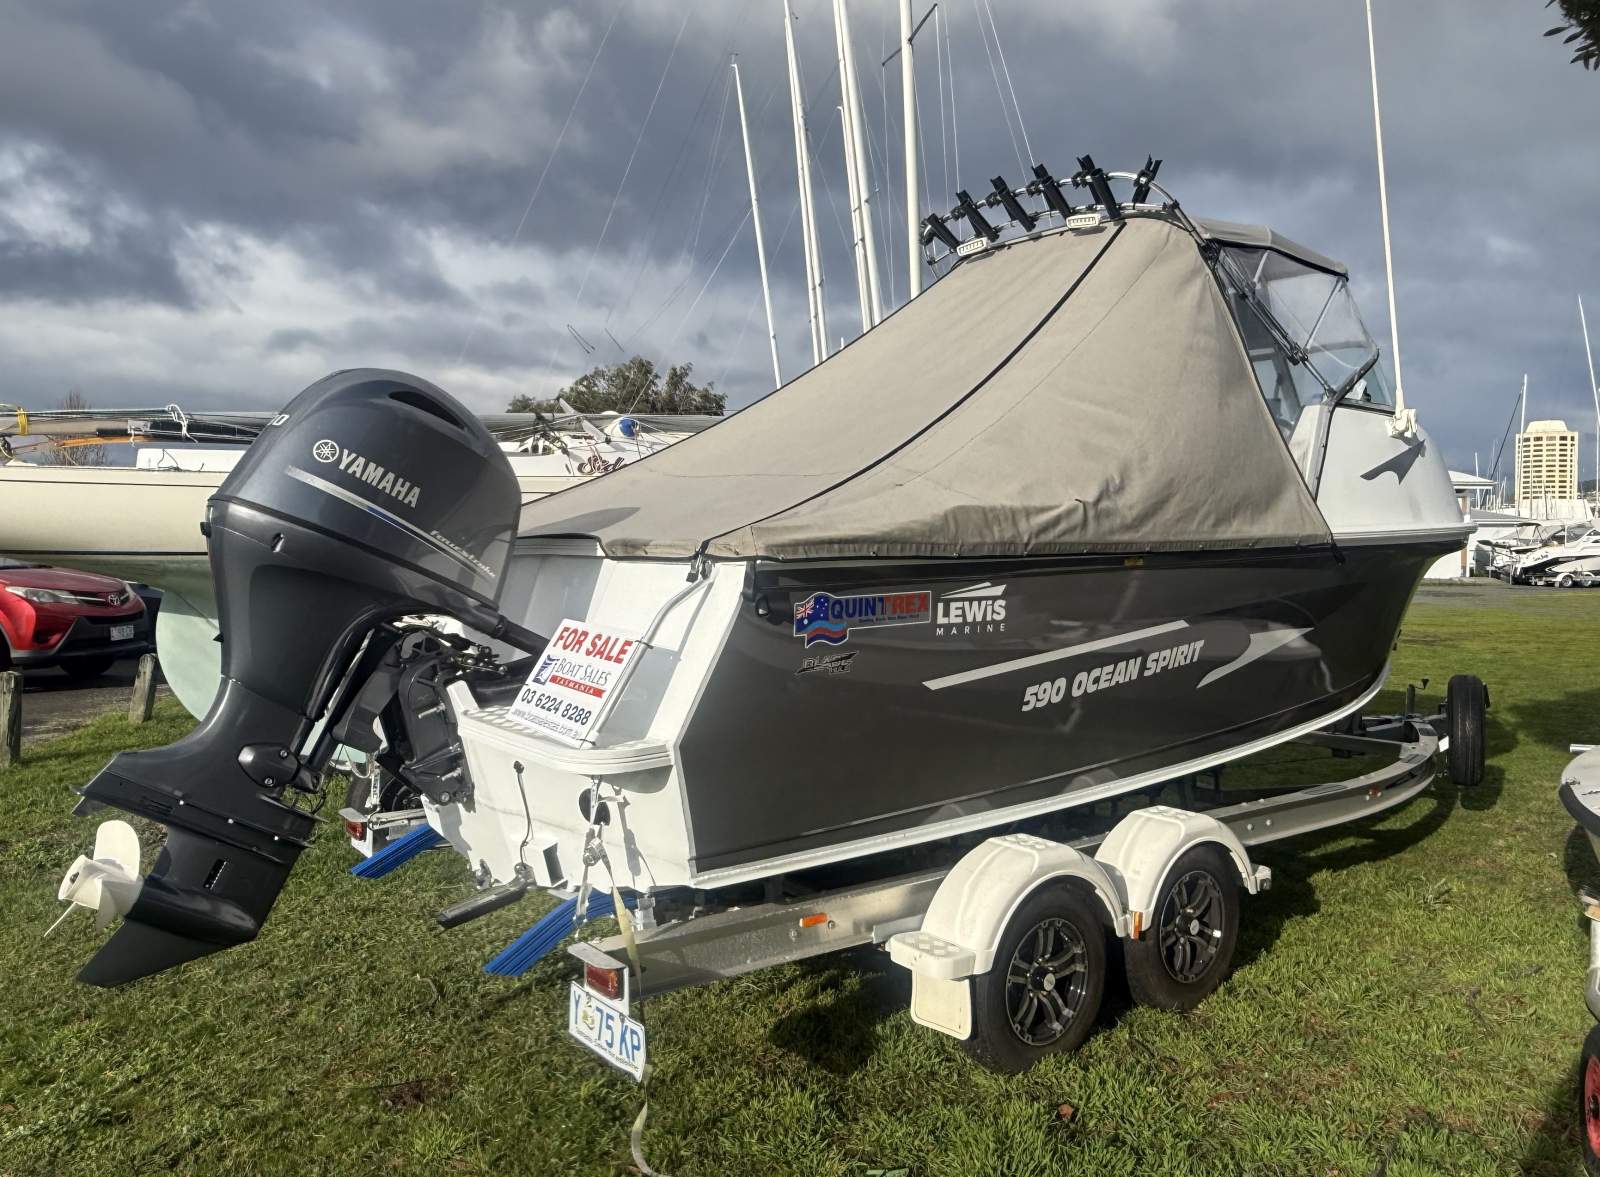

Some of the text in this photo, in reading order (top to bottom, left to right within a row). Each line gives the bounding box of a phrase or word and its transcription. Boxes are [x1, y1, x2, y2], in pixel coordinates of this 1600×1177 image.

[338, 448, 422, 508] YAMAHA
[830, 592, 929, 619] QUINTREX
[553, 626, 633, 664] FOR SALE
[936, 623, 1006, 637] MARINE
[555, 657, 612, 687] BOAT SALES
[555, 676, 595, 695] TASMANIA
[1021, 639, 1205, 712] 590 OCEAN SPIRIT
[521, 688, 537, 704] 03
[535, 693, 563, 715] 6224
[561, 702, 592, 726] 8288
